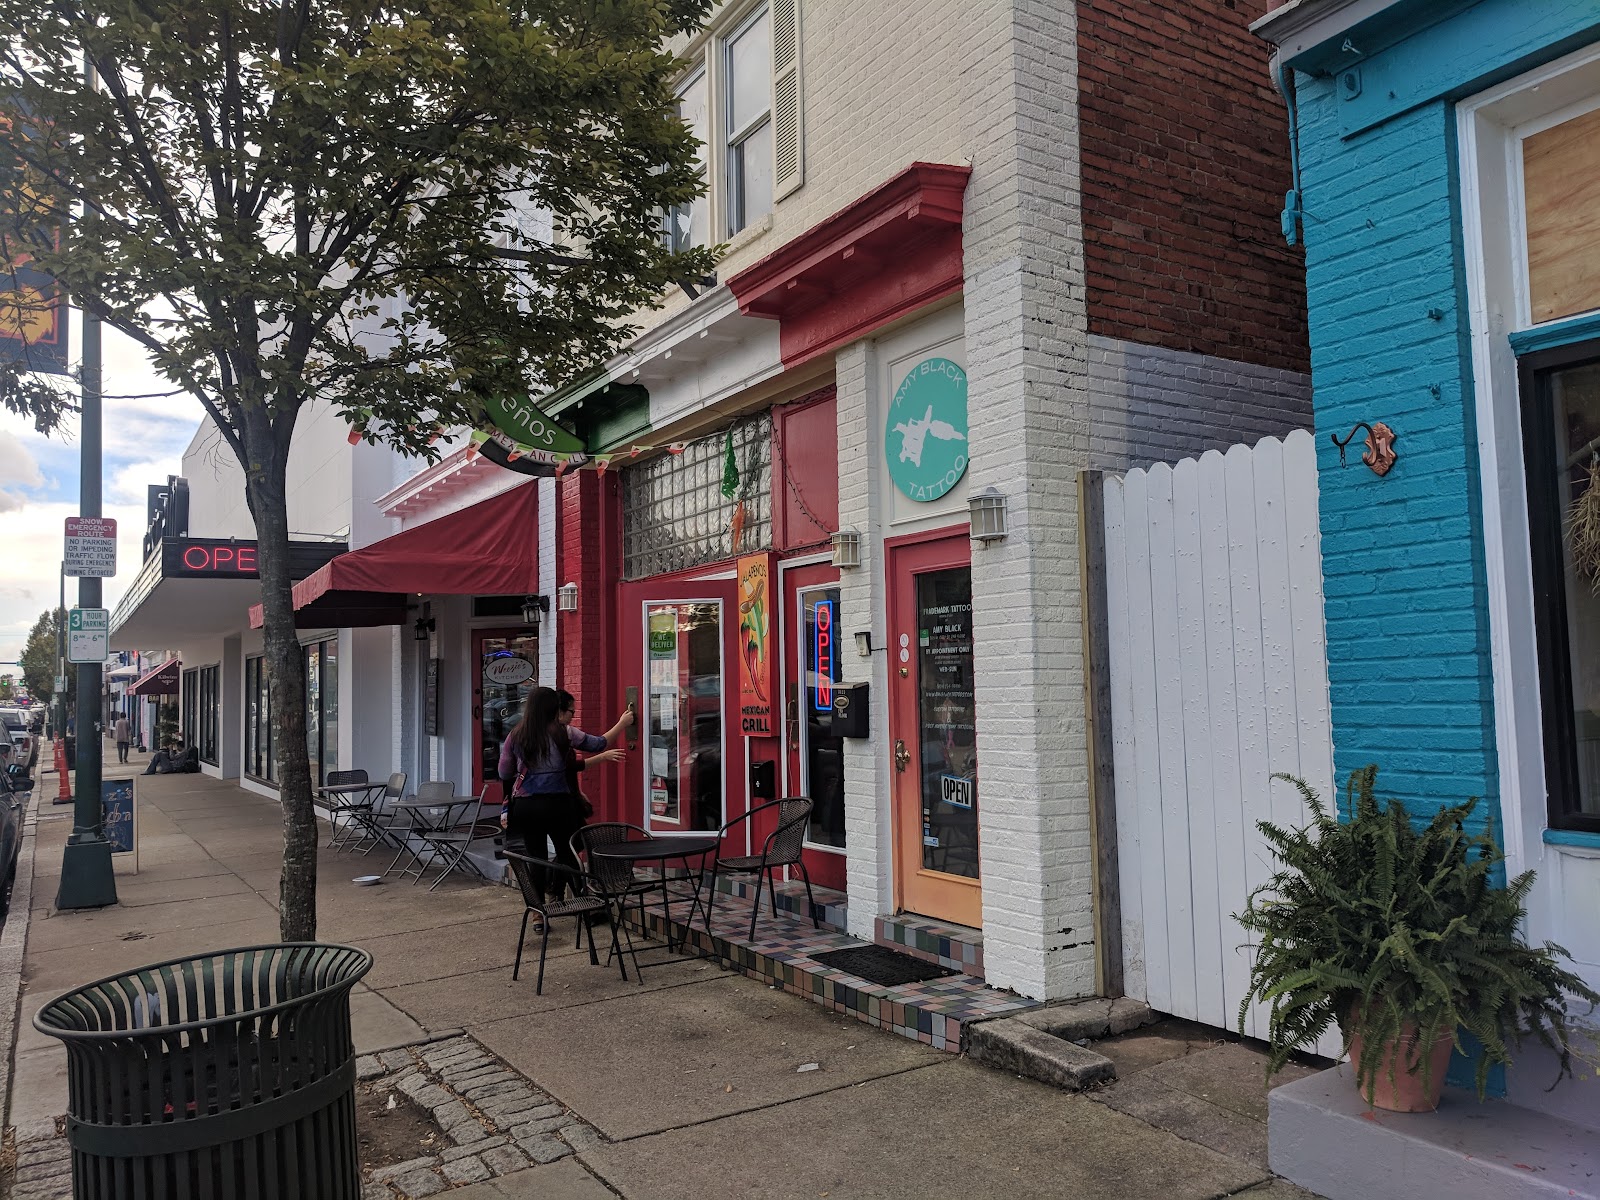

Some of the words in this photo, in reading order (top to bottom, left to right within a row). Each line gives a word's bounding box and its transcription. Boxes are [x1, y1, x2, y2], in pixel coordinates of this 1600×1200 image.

[895, 369, 917, 407] AMY
[921, 361, 963, 388] BLACK
[501, 396, 557, 445] eños
[490, 429, 546, 462] MEXAN
[909, 455, 965, 499] TATTOO
[184, 547, 257, 571] OPE
[72, 613, 80, 627] 3
[923, 606, 950, 615] TRADEMARK
[951, 604, 972, 613] TATTOO
[932, 626, 943, 634] AMY
[944, 624, 962, 632] BLACK
[817, 606, 830, 706] OPEN
[741, 706, 770, 715] MEXICAN
[742, 718, 770, 732] GRILL
[943, 778, 969, 805] OPEN
